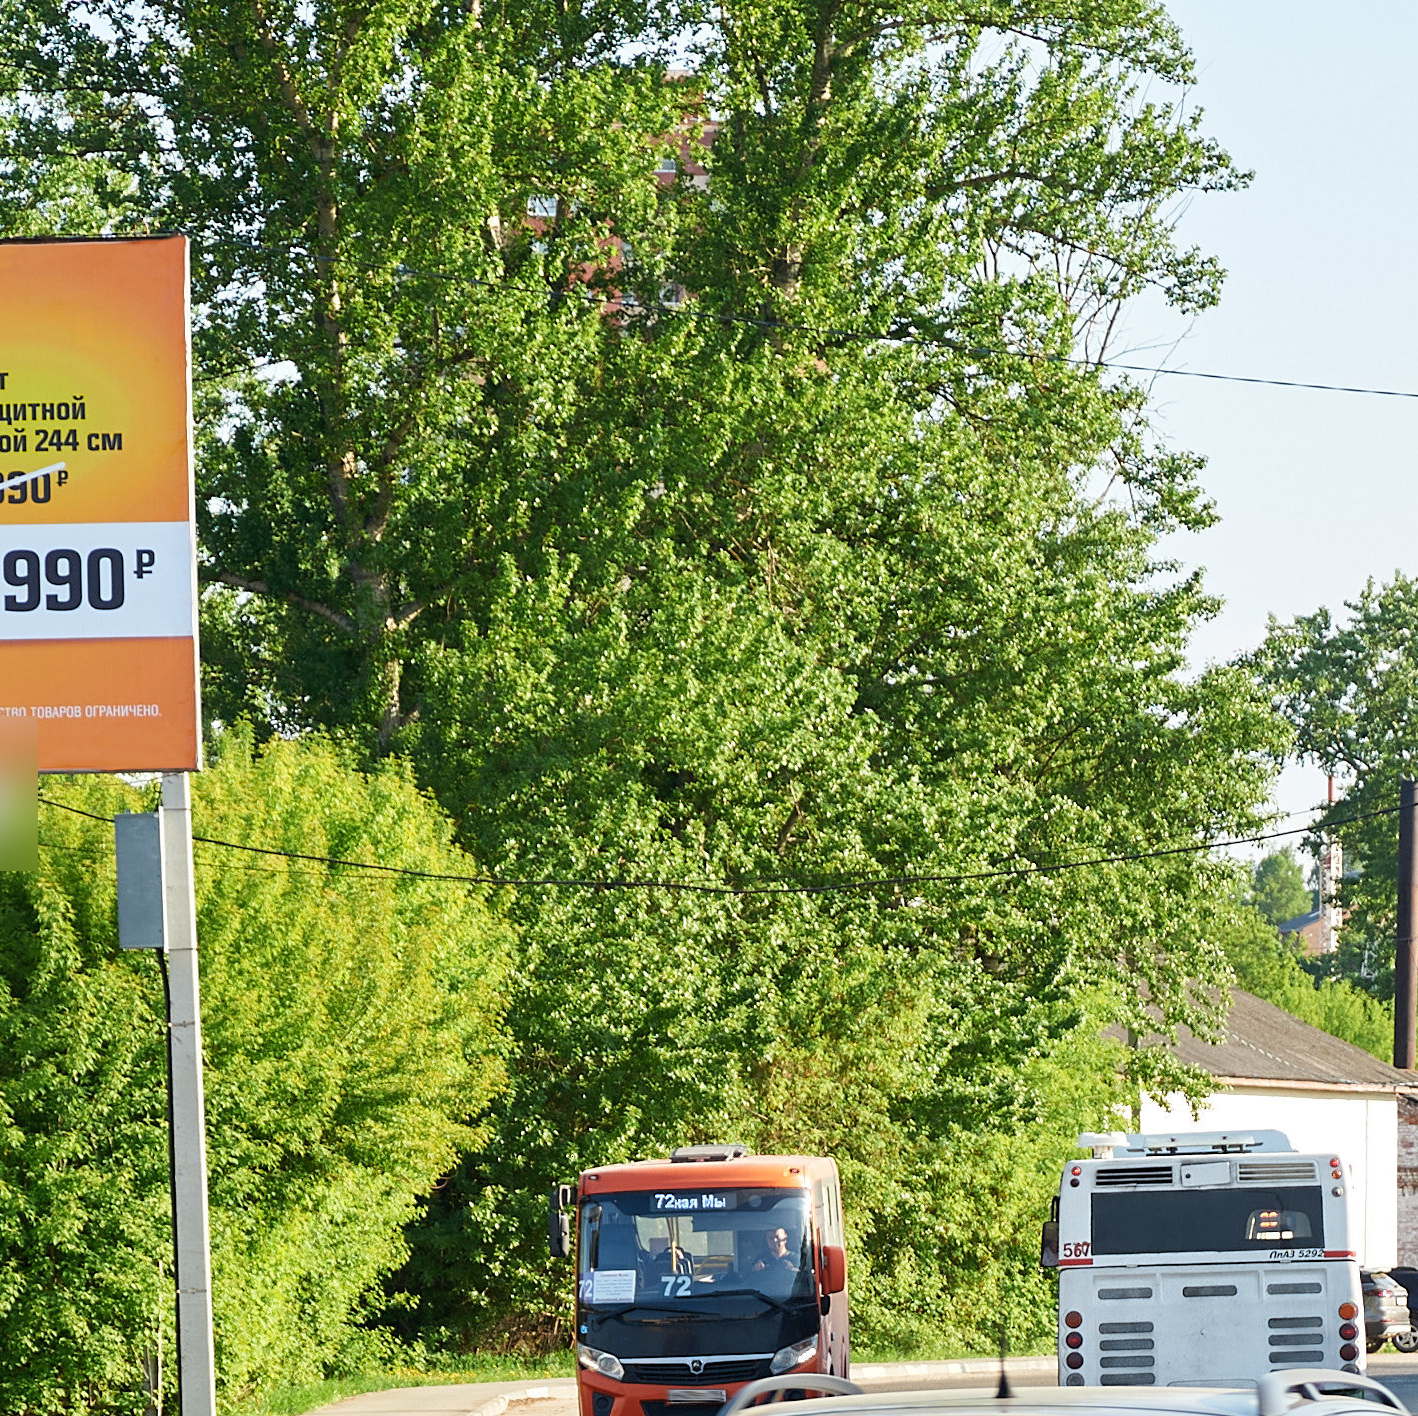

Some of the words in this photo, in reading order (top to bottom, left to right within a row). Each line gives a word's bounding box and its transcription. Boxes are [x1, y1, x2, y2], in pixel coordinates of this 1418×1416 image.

[34, 429, 80, 452] 244
[87, 433, 123, 450] см
[31, 705, 81, 718] ТОВАРОВ
[85, 704, 161, 717] ОГРАНИЧЕНО.
[1298, 1249, 1325, 1258] 5292
[661, 1276, 692, 1297] 72
